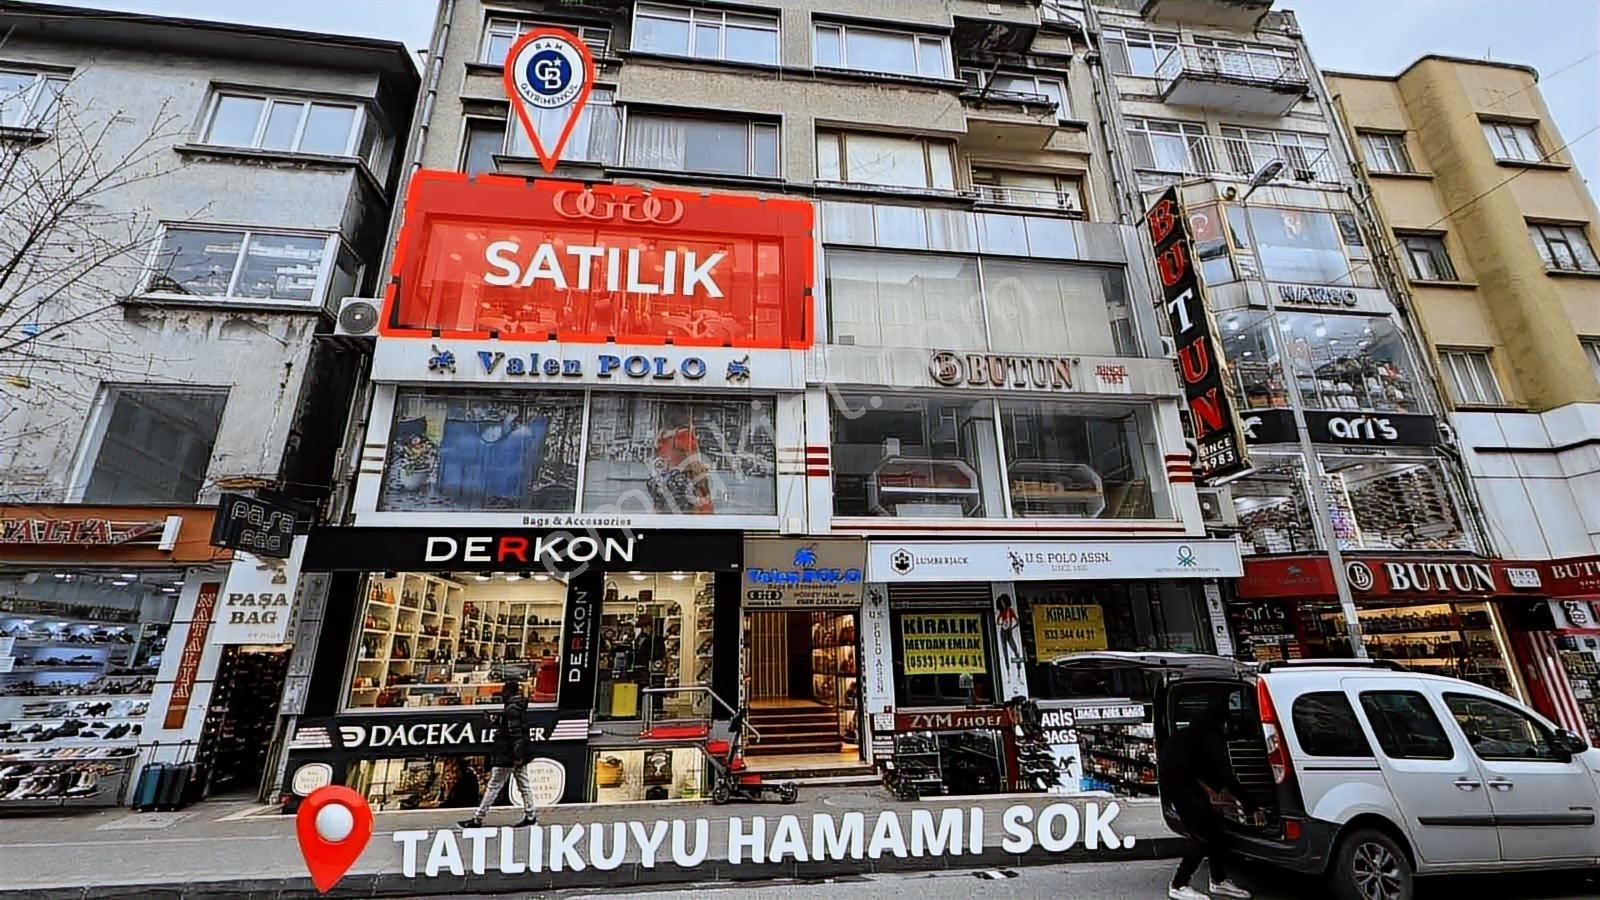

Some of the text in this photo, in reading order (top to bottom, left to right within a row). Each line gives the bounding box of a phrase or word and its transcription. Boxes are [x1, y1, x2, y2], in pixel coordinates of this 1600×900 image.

[477, 349, 707, 379] Valen POLO
[965, 353, 1077, 389] BUTUN
[1200, 437, 1232, 457] SINCE
[1202, 452, 1236, 470] 1983
[523, 516, 549, 526] Bags
[424, 535, 635, 563] DERKON
[1047, 552, 1078, 563] POLO
[1383, 563, 1498, 593] BUTUN
[226, 593, 289, 609] PAŞA
[228, 611, 279, 625] BAG
[903, 616, 980, 635] KİRALIK
[910, 714, 953, 728] ZYM
[369, 722, 476, 748] DACEKA
